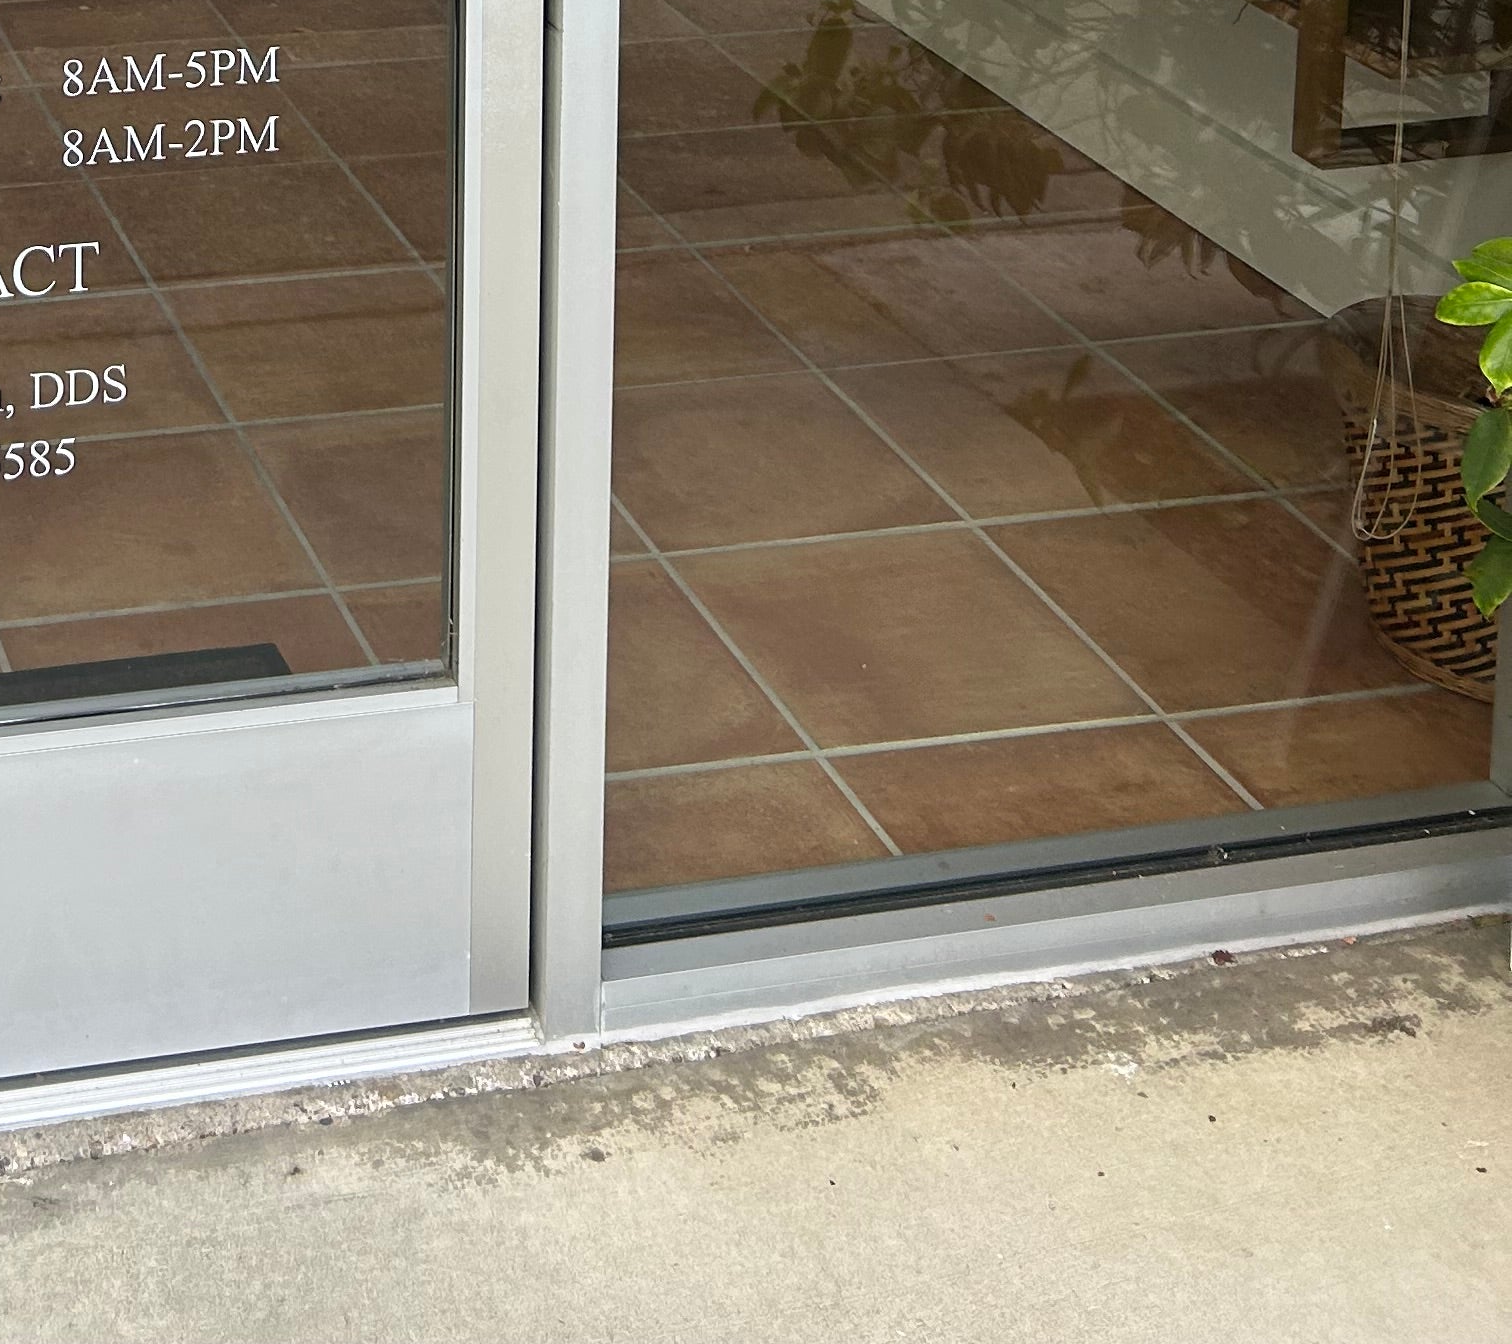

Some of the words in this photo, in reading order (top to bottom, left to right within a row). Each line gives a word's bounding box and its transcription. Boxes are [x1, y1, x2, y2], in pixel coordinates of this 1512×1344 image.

[61, 46, 280, 97] 8AM-5PM
[61, 115, 280, 167] 8AM-2PM
[30, 364, 128, 410] DDS
